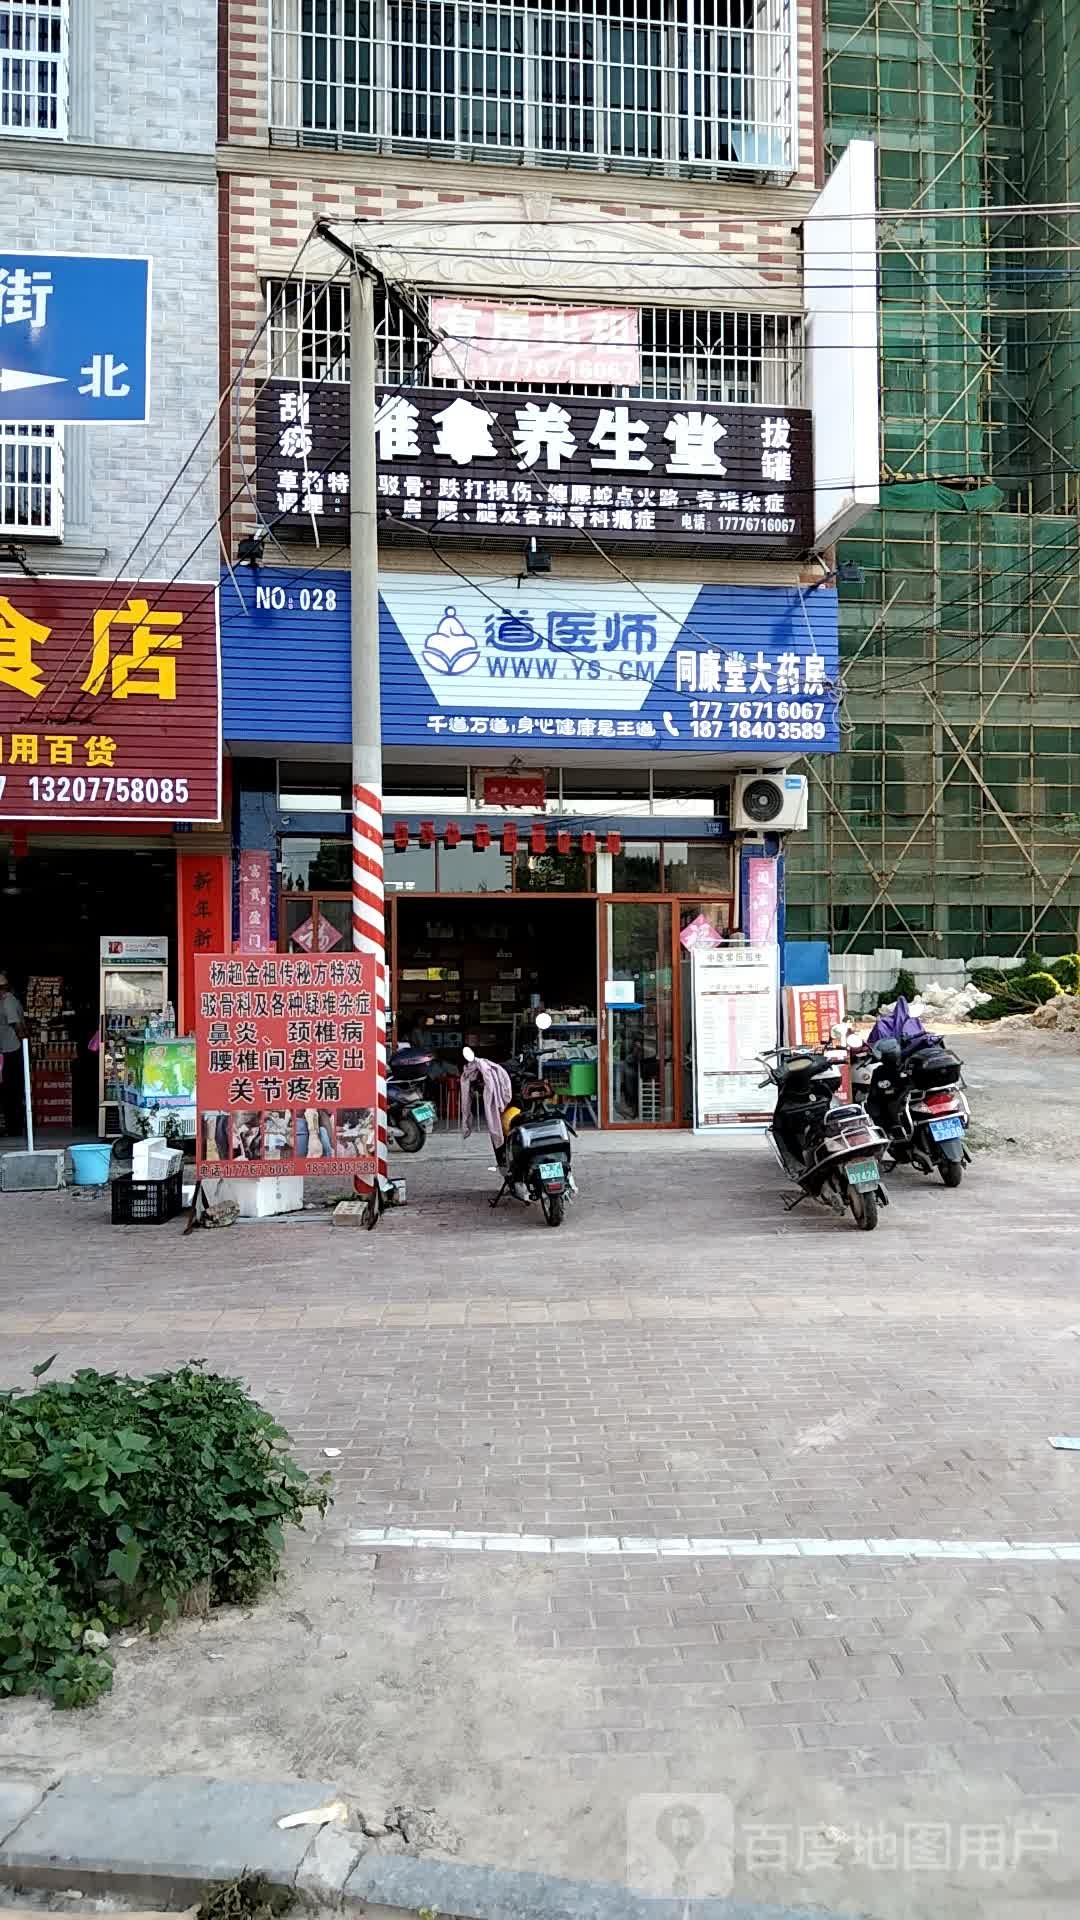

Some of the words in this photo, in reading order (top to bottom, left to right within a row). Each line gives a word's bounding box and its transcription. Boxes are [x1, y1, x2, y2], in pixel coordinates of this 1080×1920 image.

[0, 268, 54, 328] 街
[78, 354, 131, 398] 北
[279, 392, 313, 459] 刮痧
[761, 416, 793, 482] 拔罐
[485, 608, 658, 655] 道医师
[675, 650, 826, 697] 同康堂大药房
[0, 733, 117, 767] 用百货
[28, 775, 189, 804] 13207758085
[209, 959, 363, 986] 杨超金祖传秘方特效
[201, 991, 371, 1018] 驳骨科及各种疑难杂症
[208, 1048, 366, 1073] 腰椎间盘突出
[229, 1076, 343, 1104] 关节疼痛
